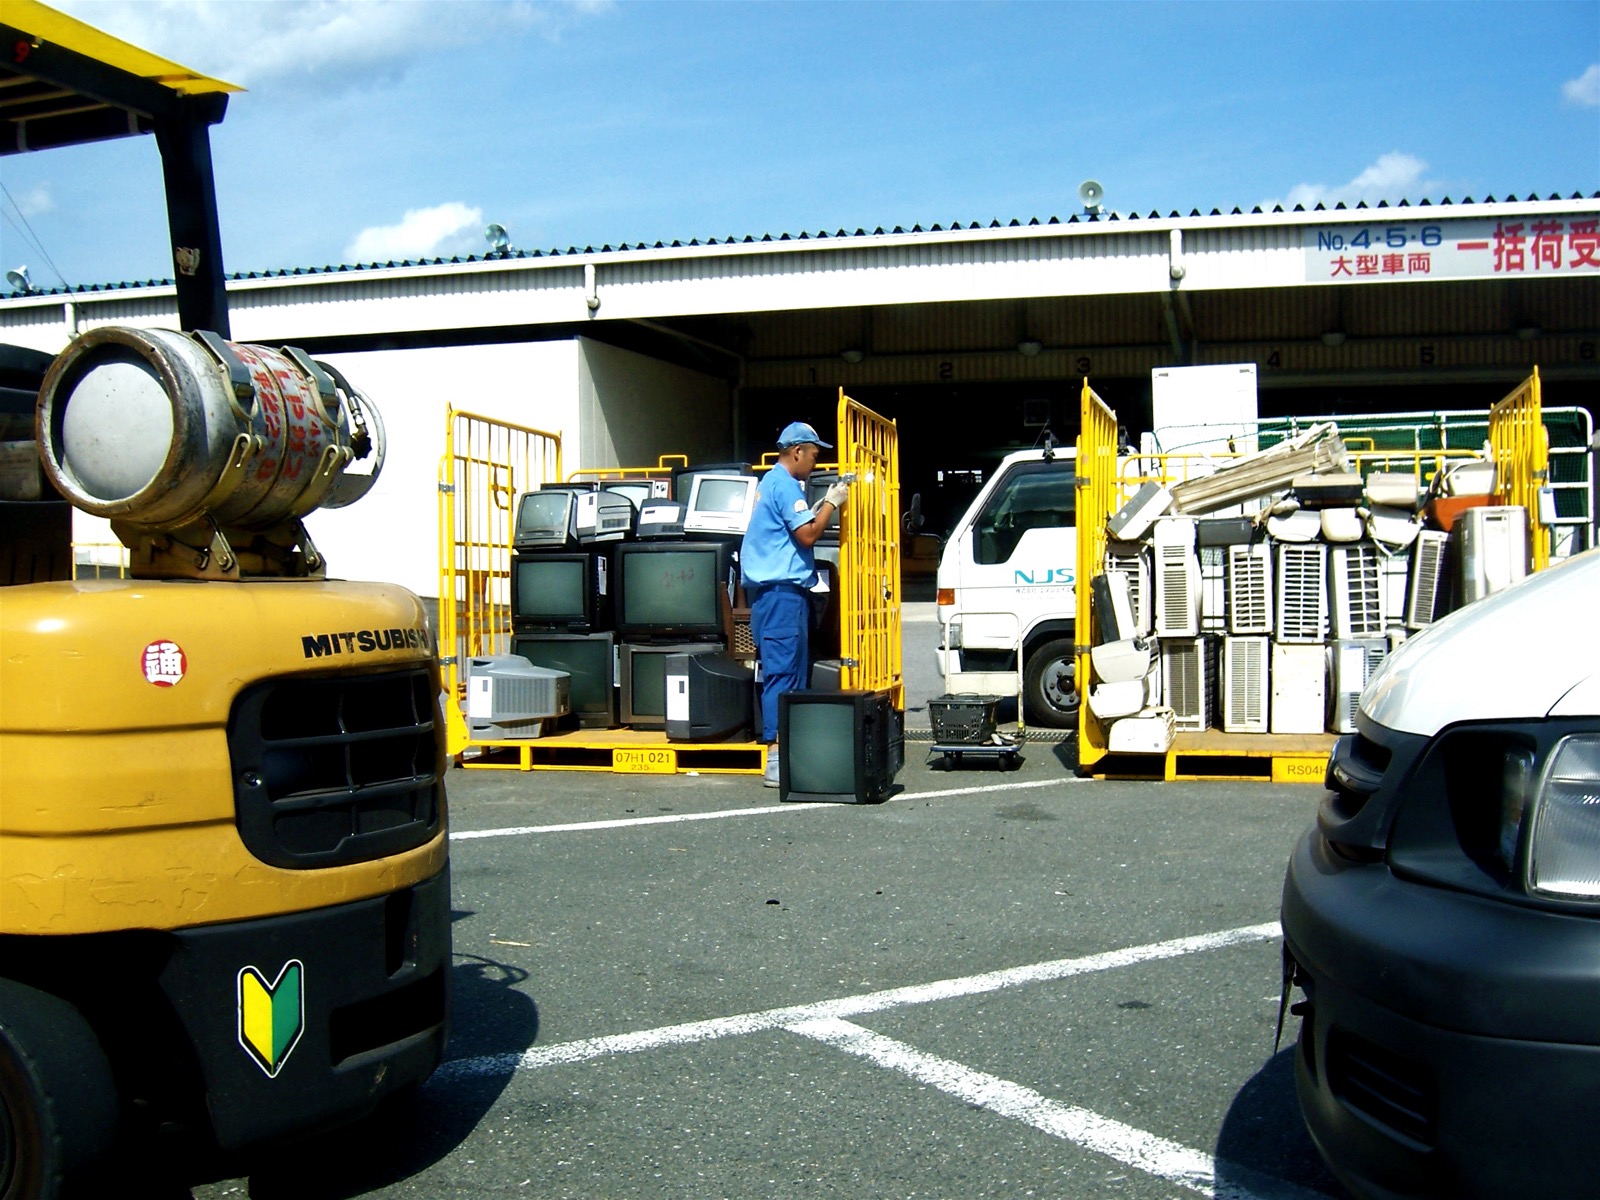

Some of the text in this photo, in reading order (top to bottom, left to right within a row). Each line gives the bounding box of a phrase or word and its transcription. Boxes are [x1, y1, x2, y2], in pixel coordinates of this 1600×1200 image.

[1457, 219, 1600, 272] 一括荷受
[1330, 252, 1431, 276] 大型車両
[1421, 346, 1435, 363] 5
[1580, 341, 1595, 359] 6
[1077, 357, 1092, 374] 3
[1267, 351, 1281, 367] 4
[808, 368, 816, 384] 1
[939, 362, 953, 379] 2
[1014, 568, 1075, 584] NJS
[144, 642, 183, 686] 通
